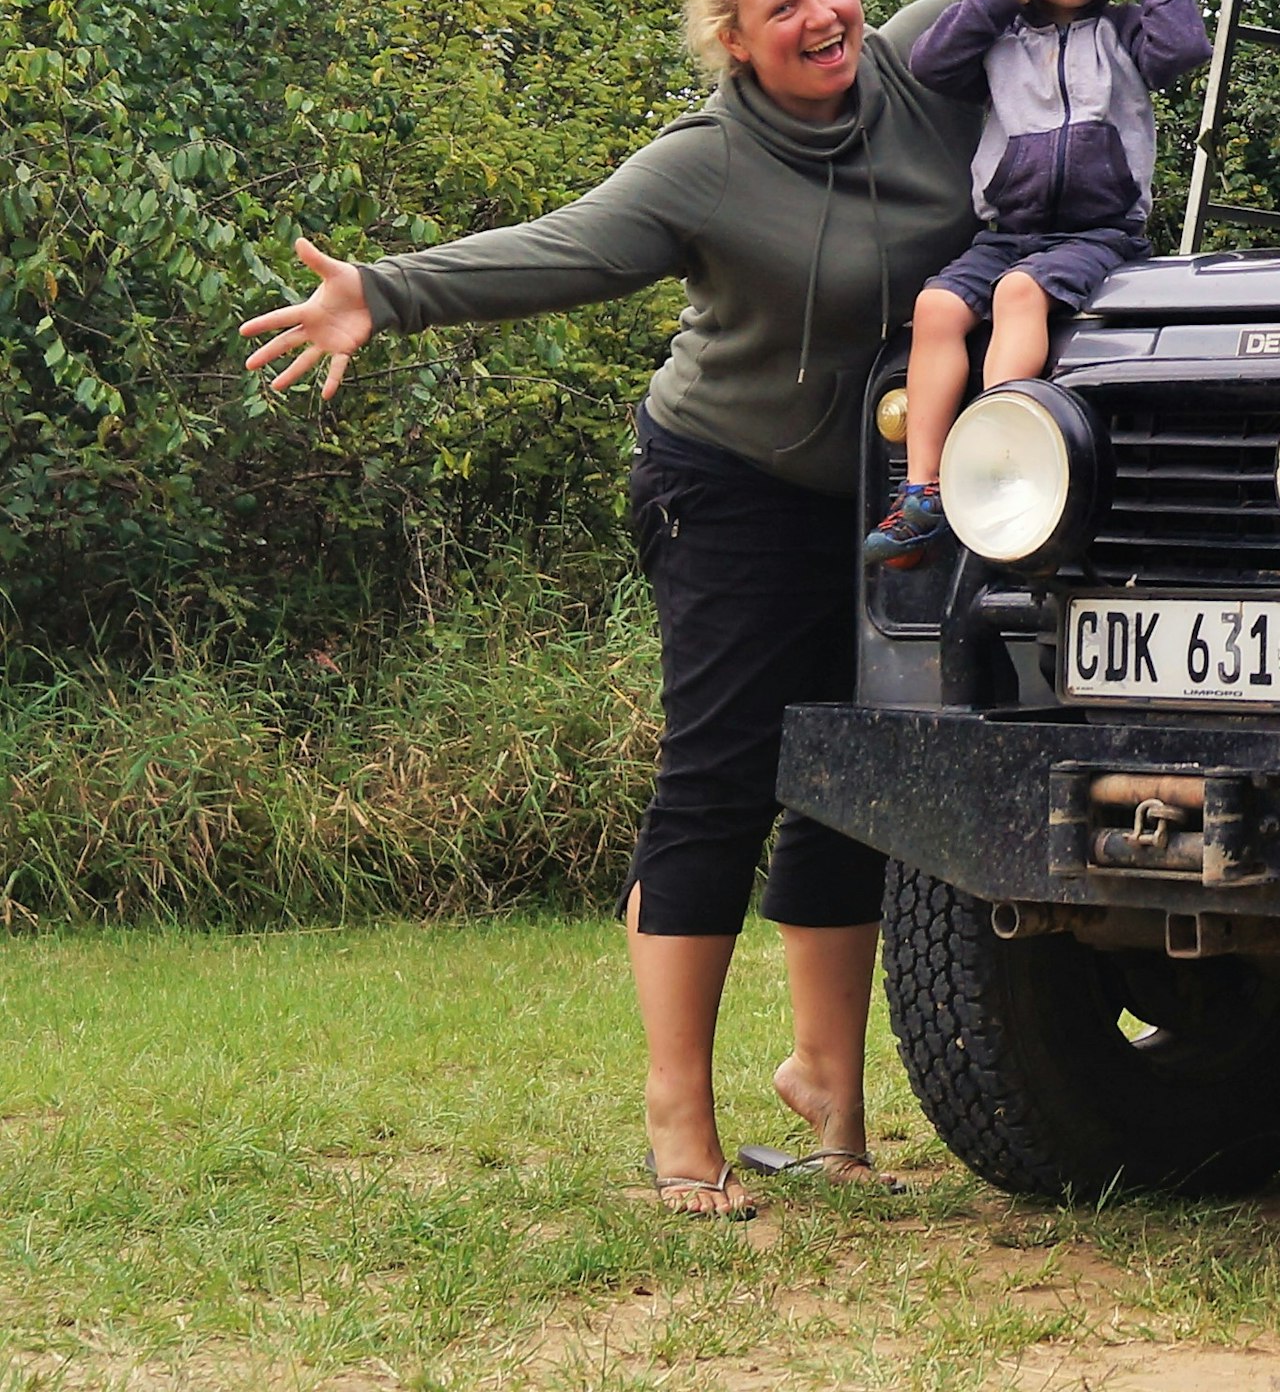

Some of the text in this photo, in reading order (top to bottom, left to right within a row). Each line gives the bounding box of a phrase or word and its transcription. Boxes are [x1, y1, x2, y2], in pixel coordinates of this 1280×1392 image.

[1075, 610, 1161, 683] CDK
[1186, 611, 1273, 687] 631
[1183, 688, 1243, 697] LIMPOPO
